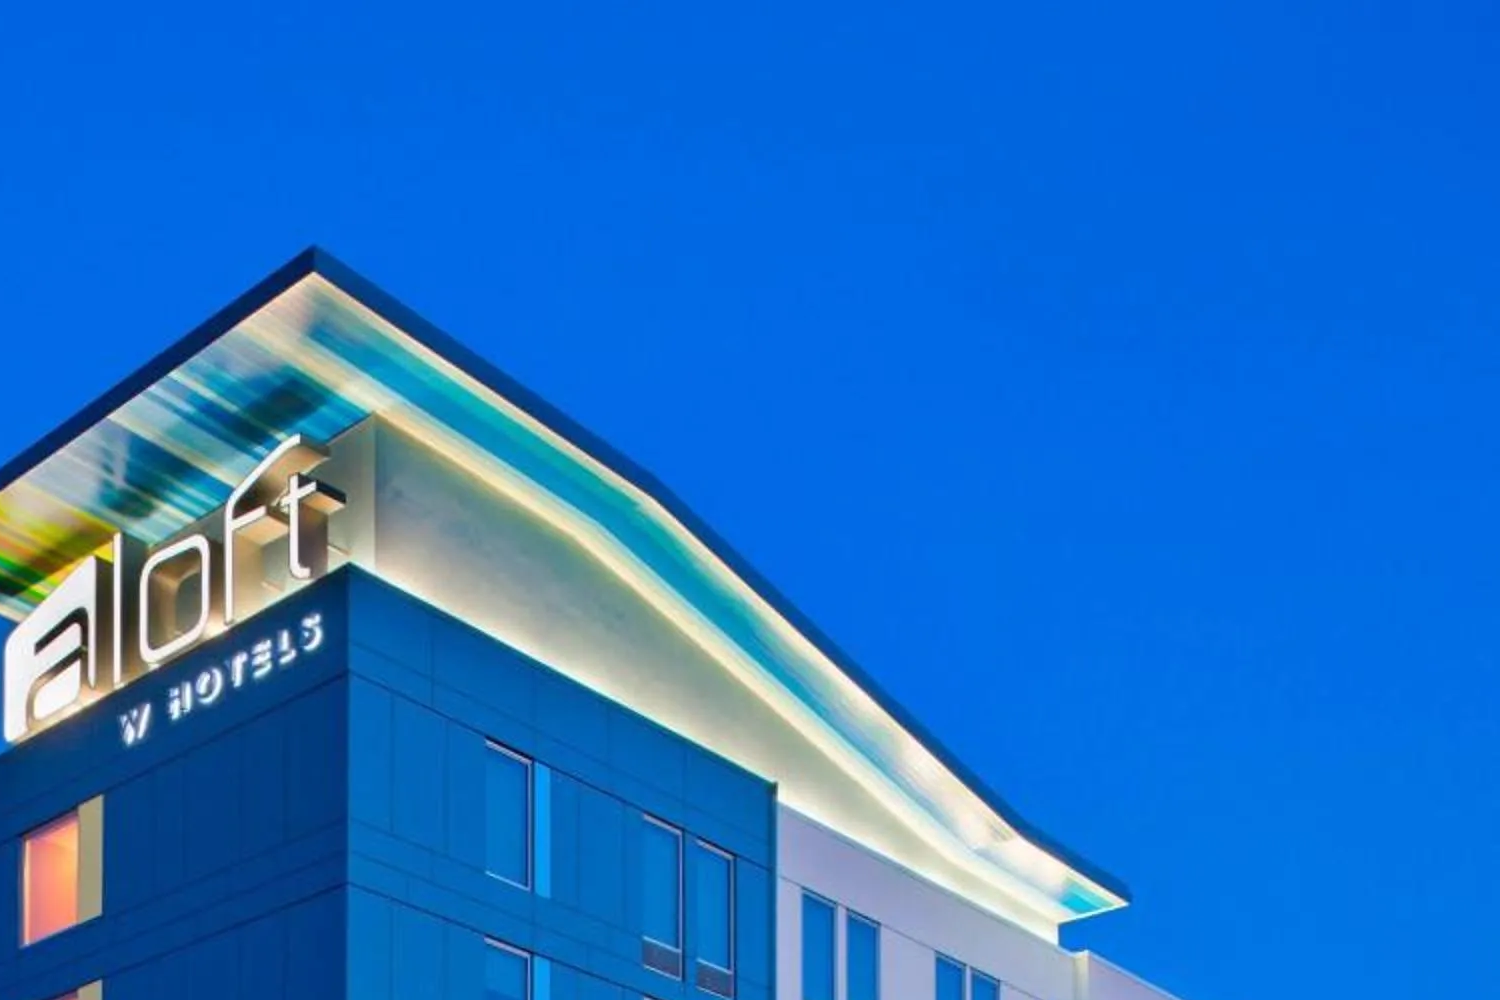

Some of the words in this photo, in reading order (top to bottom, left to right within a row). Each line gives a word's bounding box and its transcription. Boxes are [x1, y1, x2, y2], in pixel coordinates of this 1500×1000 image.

[3, 432, 318, 743] aloft
[118, 702, 152, 746] W
[167, 611, 324, 721] HOTELS
